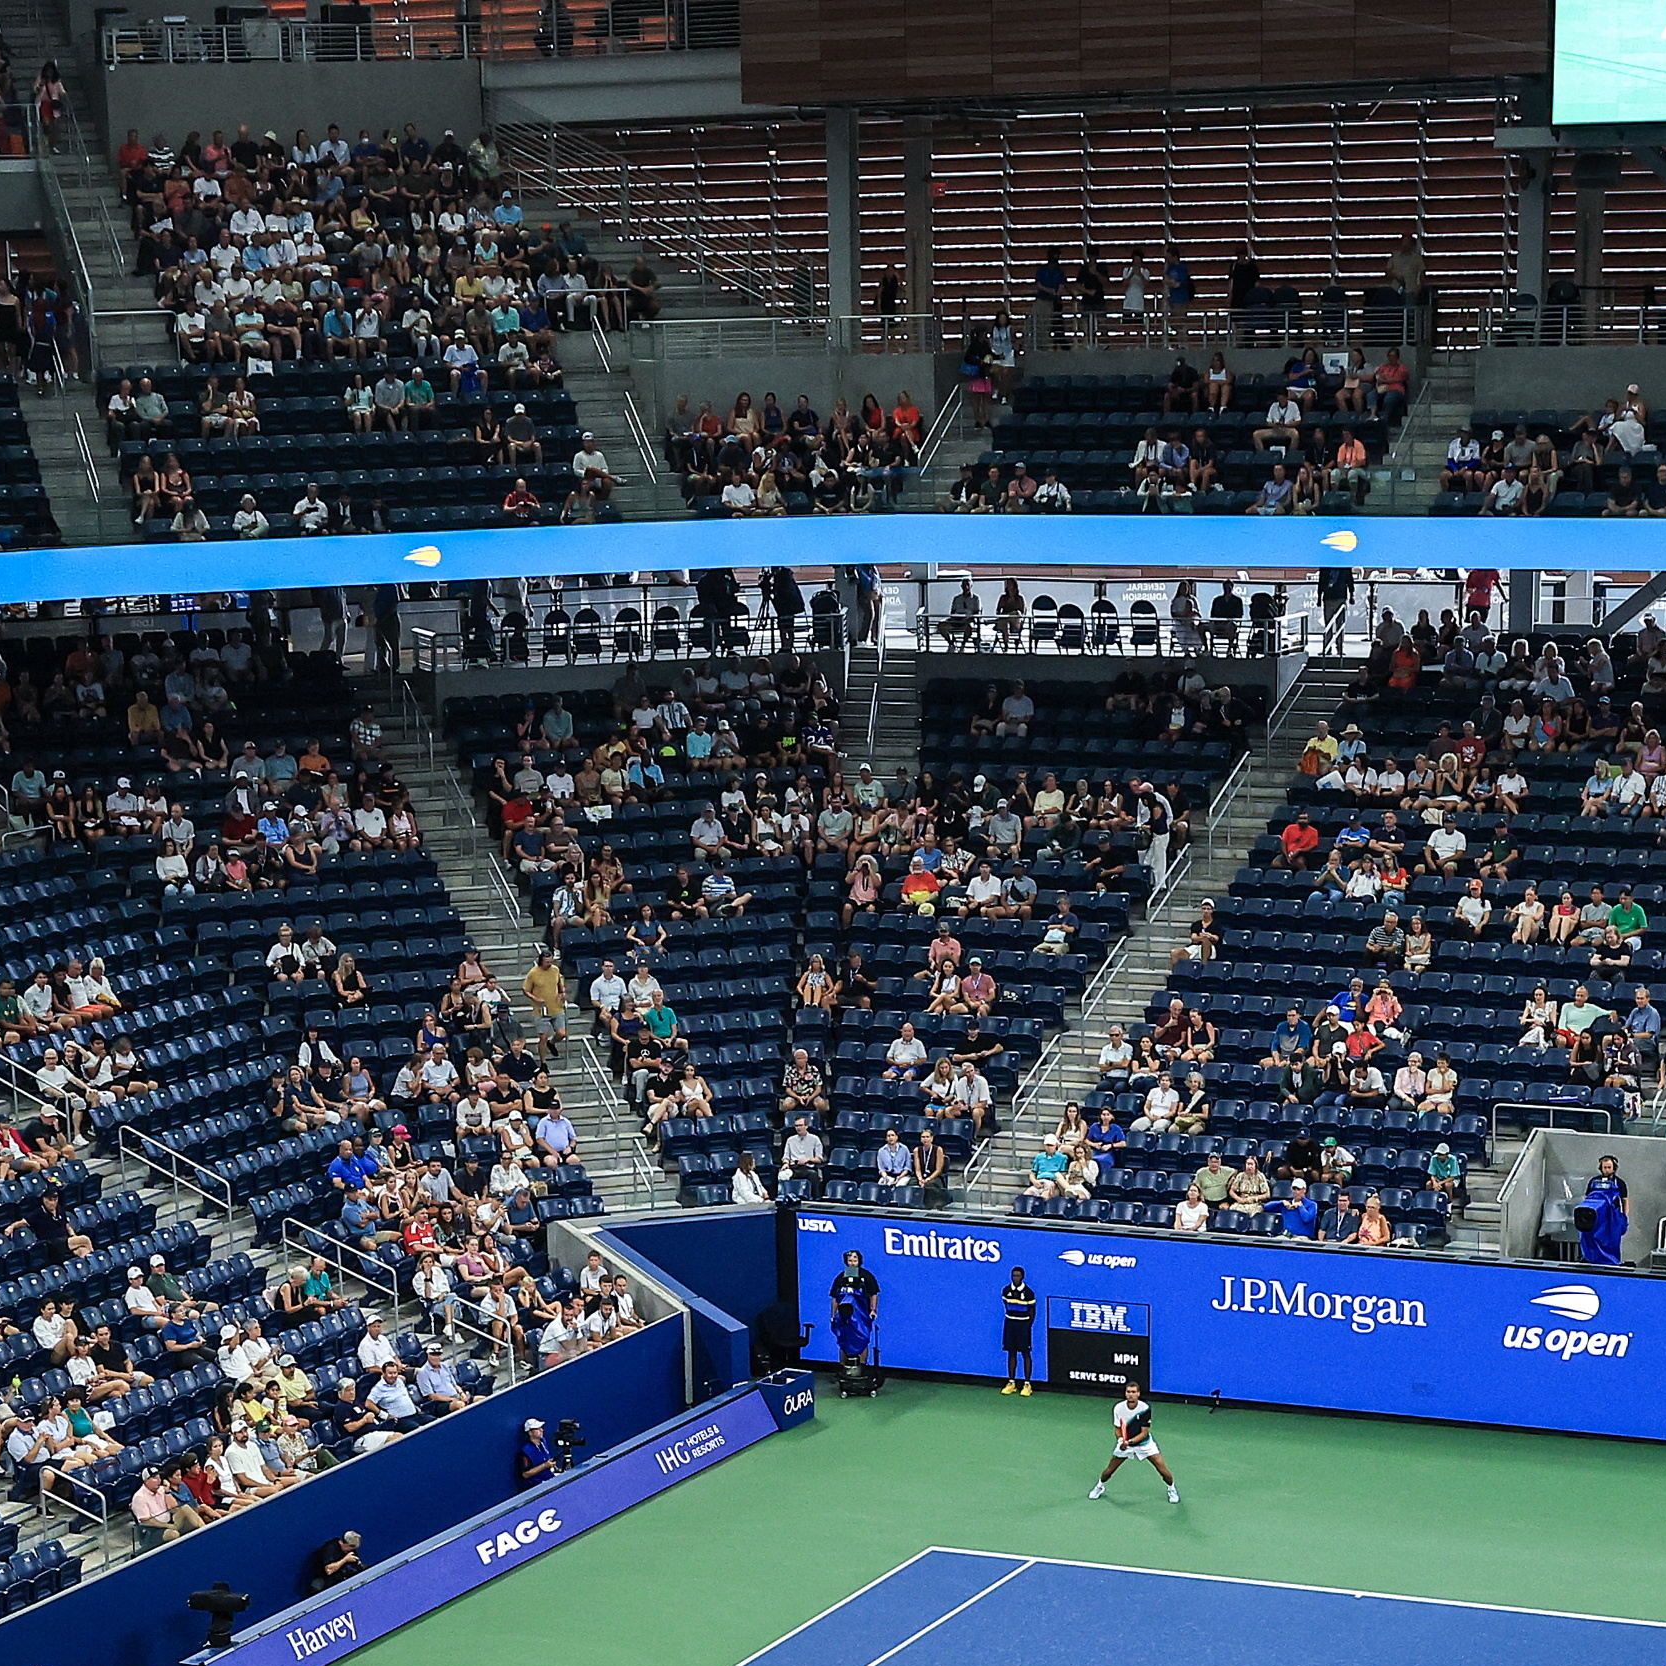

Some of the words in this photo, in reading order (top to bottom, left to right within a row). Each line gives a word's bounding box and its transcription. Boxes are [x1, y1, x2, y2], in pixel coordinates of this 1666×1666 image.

[798, 1218, 837, 1234] USTA
[884, 1227, 1001, 1263] Emirates
[1087, 1252, 1102, 1266] us
[1103, 1254, 1137, 1269] open
[1212, 1276, 1428, 1333] J.P.Morgan
[1503, 1324, 1543, 1351] us
[1544, 1331, 1632, 1361] open
[1114, 1352, 1139, 1366] MPH
[1069, 1370, 1096, 1383] SERVE
[1098, 1371, 1127, 1385] SPEED
[655, 1441, 691, 1474] IHG
[686, 1427, 713, 1447] HOTELS
[713, 1424, 720, 1434] &
[692, 1435, 726, 1459] RESORTS
[286, 1610, 357, 1660] Harvey
